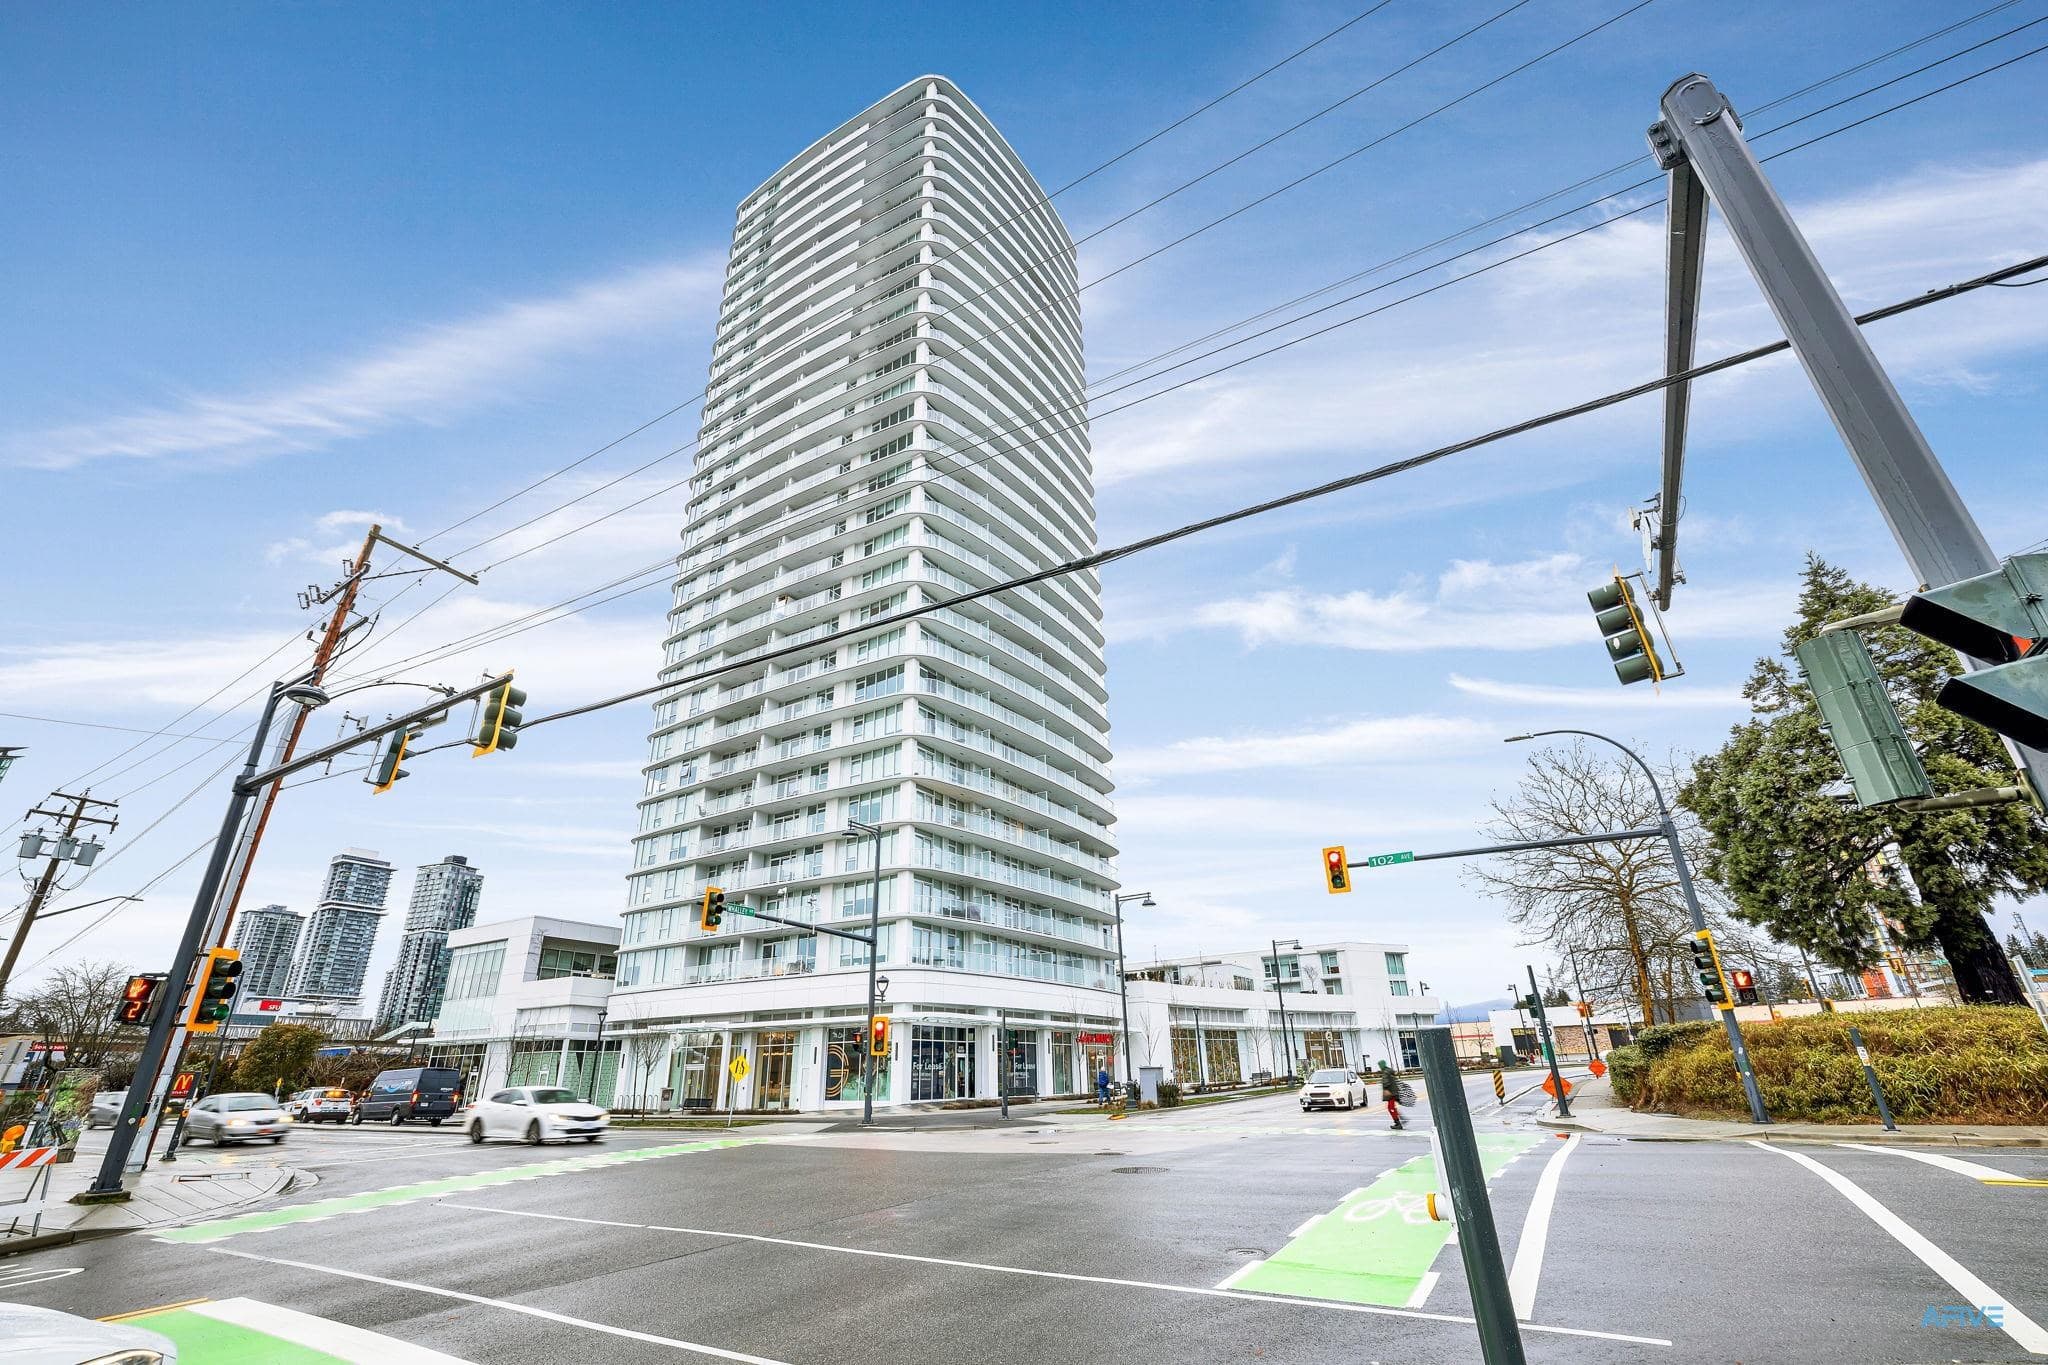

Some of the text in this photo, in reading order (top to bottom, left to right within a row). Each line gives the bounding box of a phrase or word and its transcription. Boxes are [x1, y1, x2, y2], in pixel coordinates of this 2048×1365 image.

[1371, 856, 1395, 866] 102
[128, 1002, 140, 1017] 2
[912, 1061, 944, 1070] For Lease
